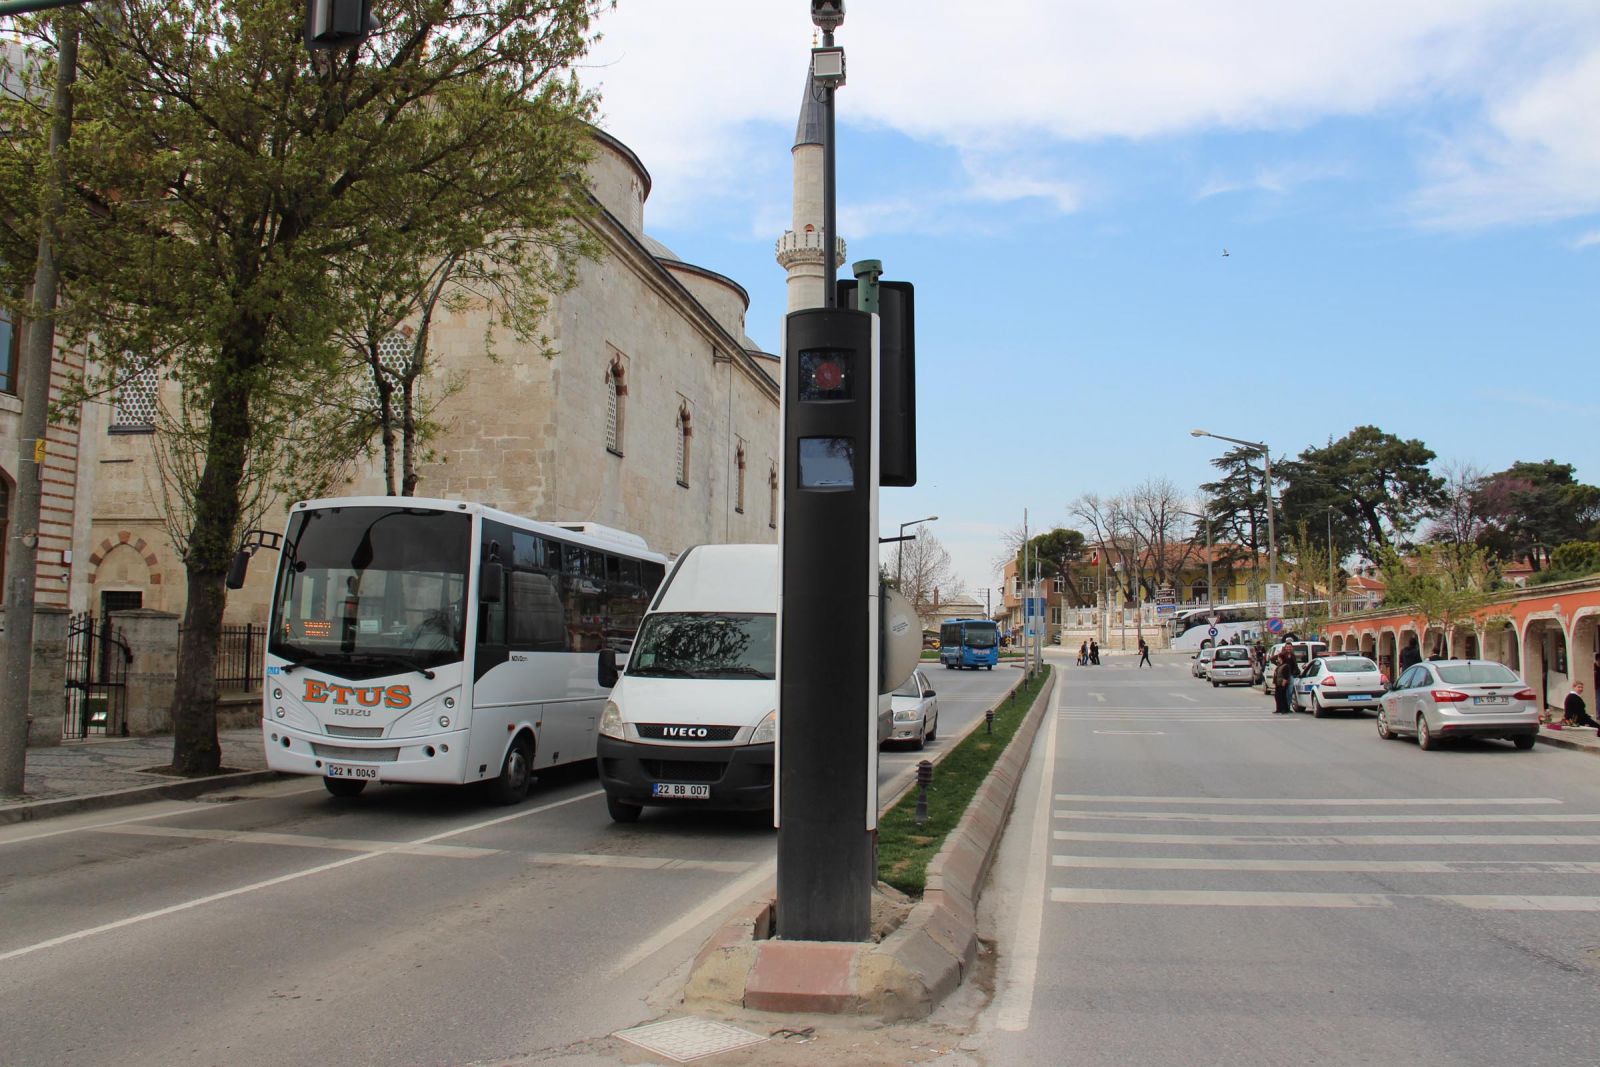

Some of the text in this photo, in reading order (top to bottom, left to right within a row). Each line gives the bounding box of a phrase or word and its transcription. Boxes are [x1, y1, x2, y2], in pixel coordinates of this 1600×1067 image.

[302, 678, 412, 709] ETUS
[334, 708, 371, 717] ISUZU
[663, 727, 708, 737] IVECO
[333, 766, 344, 776] 22
[356, 768, 376, 778] 0049
[658, 784, 708, 795] 22 BB 007
